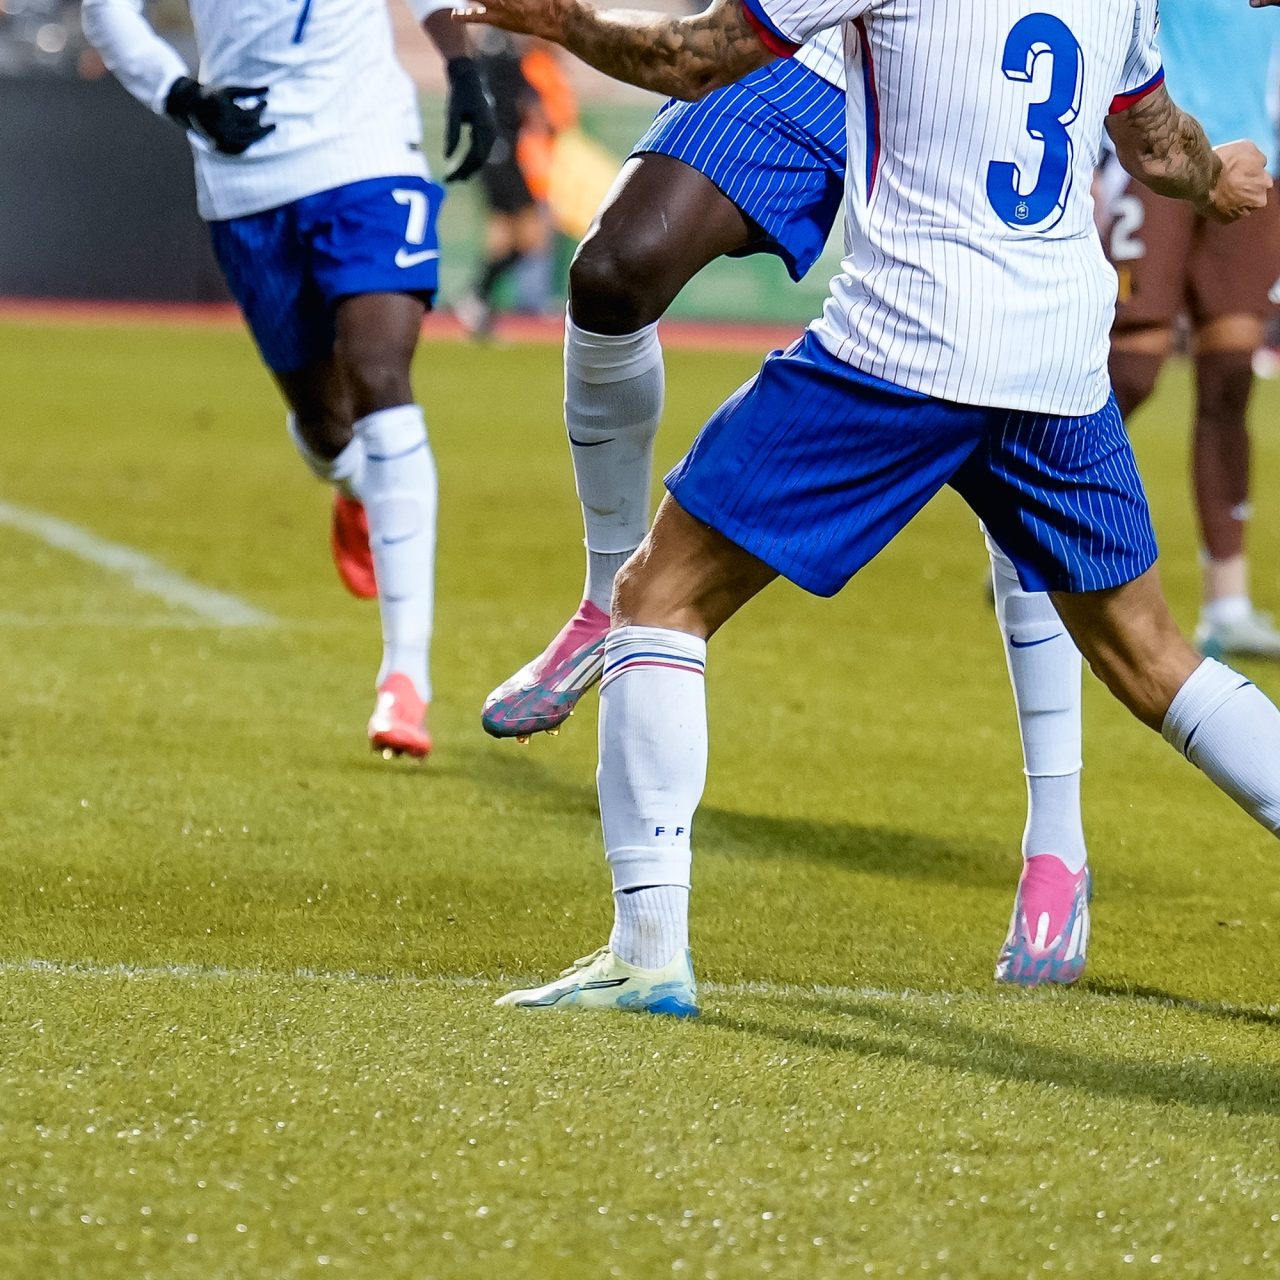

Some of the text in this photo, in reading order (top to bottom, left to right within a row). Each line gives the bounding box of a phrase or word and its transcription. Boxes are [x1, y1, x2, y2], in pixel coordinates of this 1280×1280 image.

[985, 12, 1085, 233] 3
[390, 188, 430, 246] 7
[1108, 194, 1146, 261] 2
